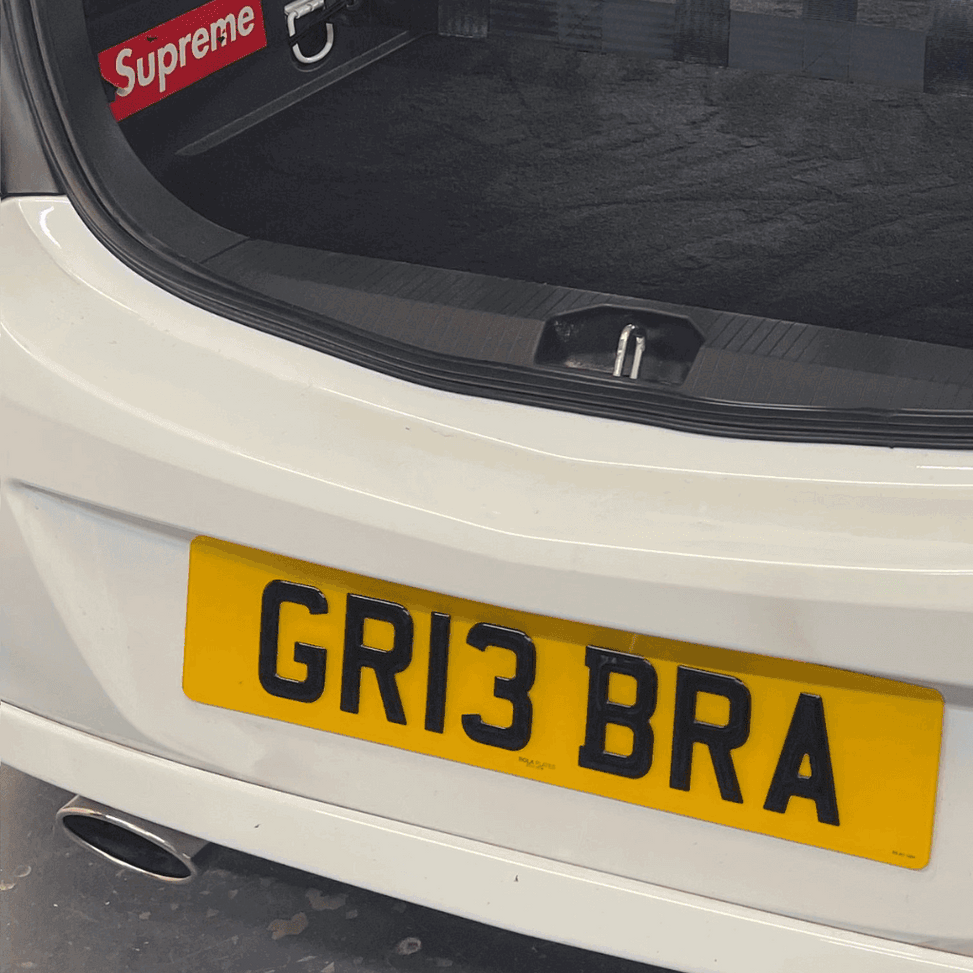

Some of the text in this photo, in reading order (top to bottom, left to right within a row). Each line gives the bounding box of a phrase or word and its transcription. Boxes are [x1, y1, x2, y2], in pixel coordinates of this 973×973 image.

[115, 5, 255, 97] Supreme
[259, 580, 840, 826] GR13 BRA
